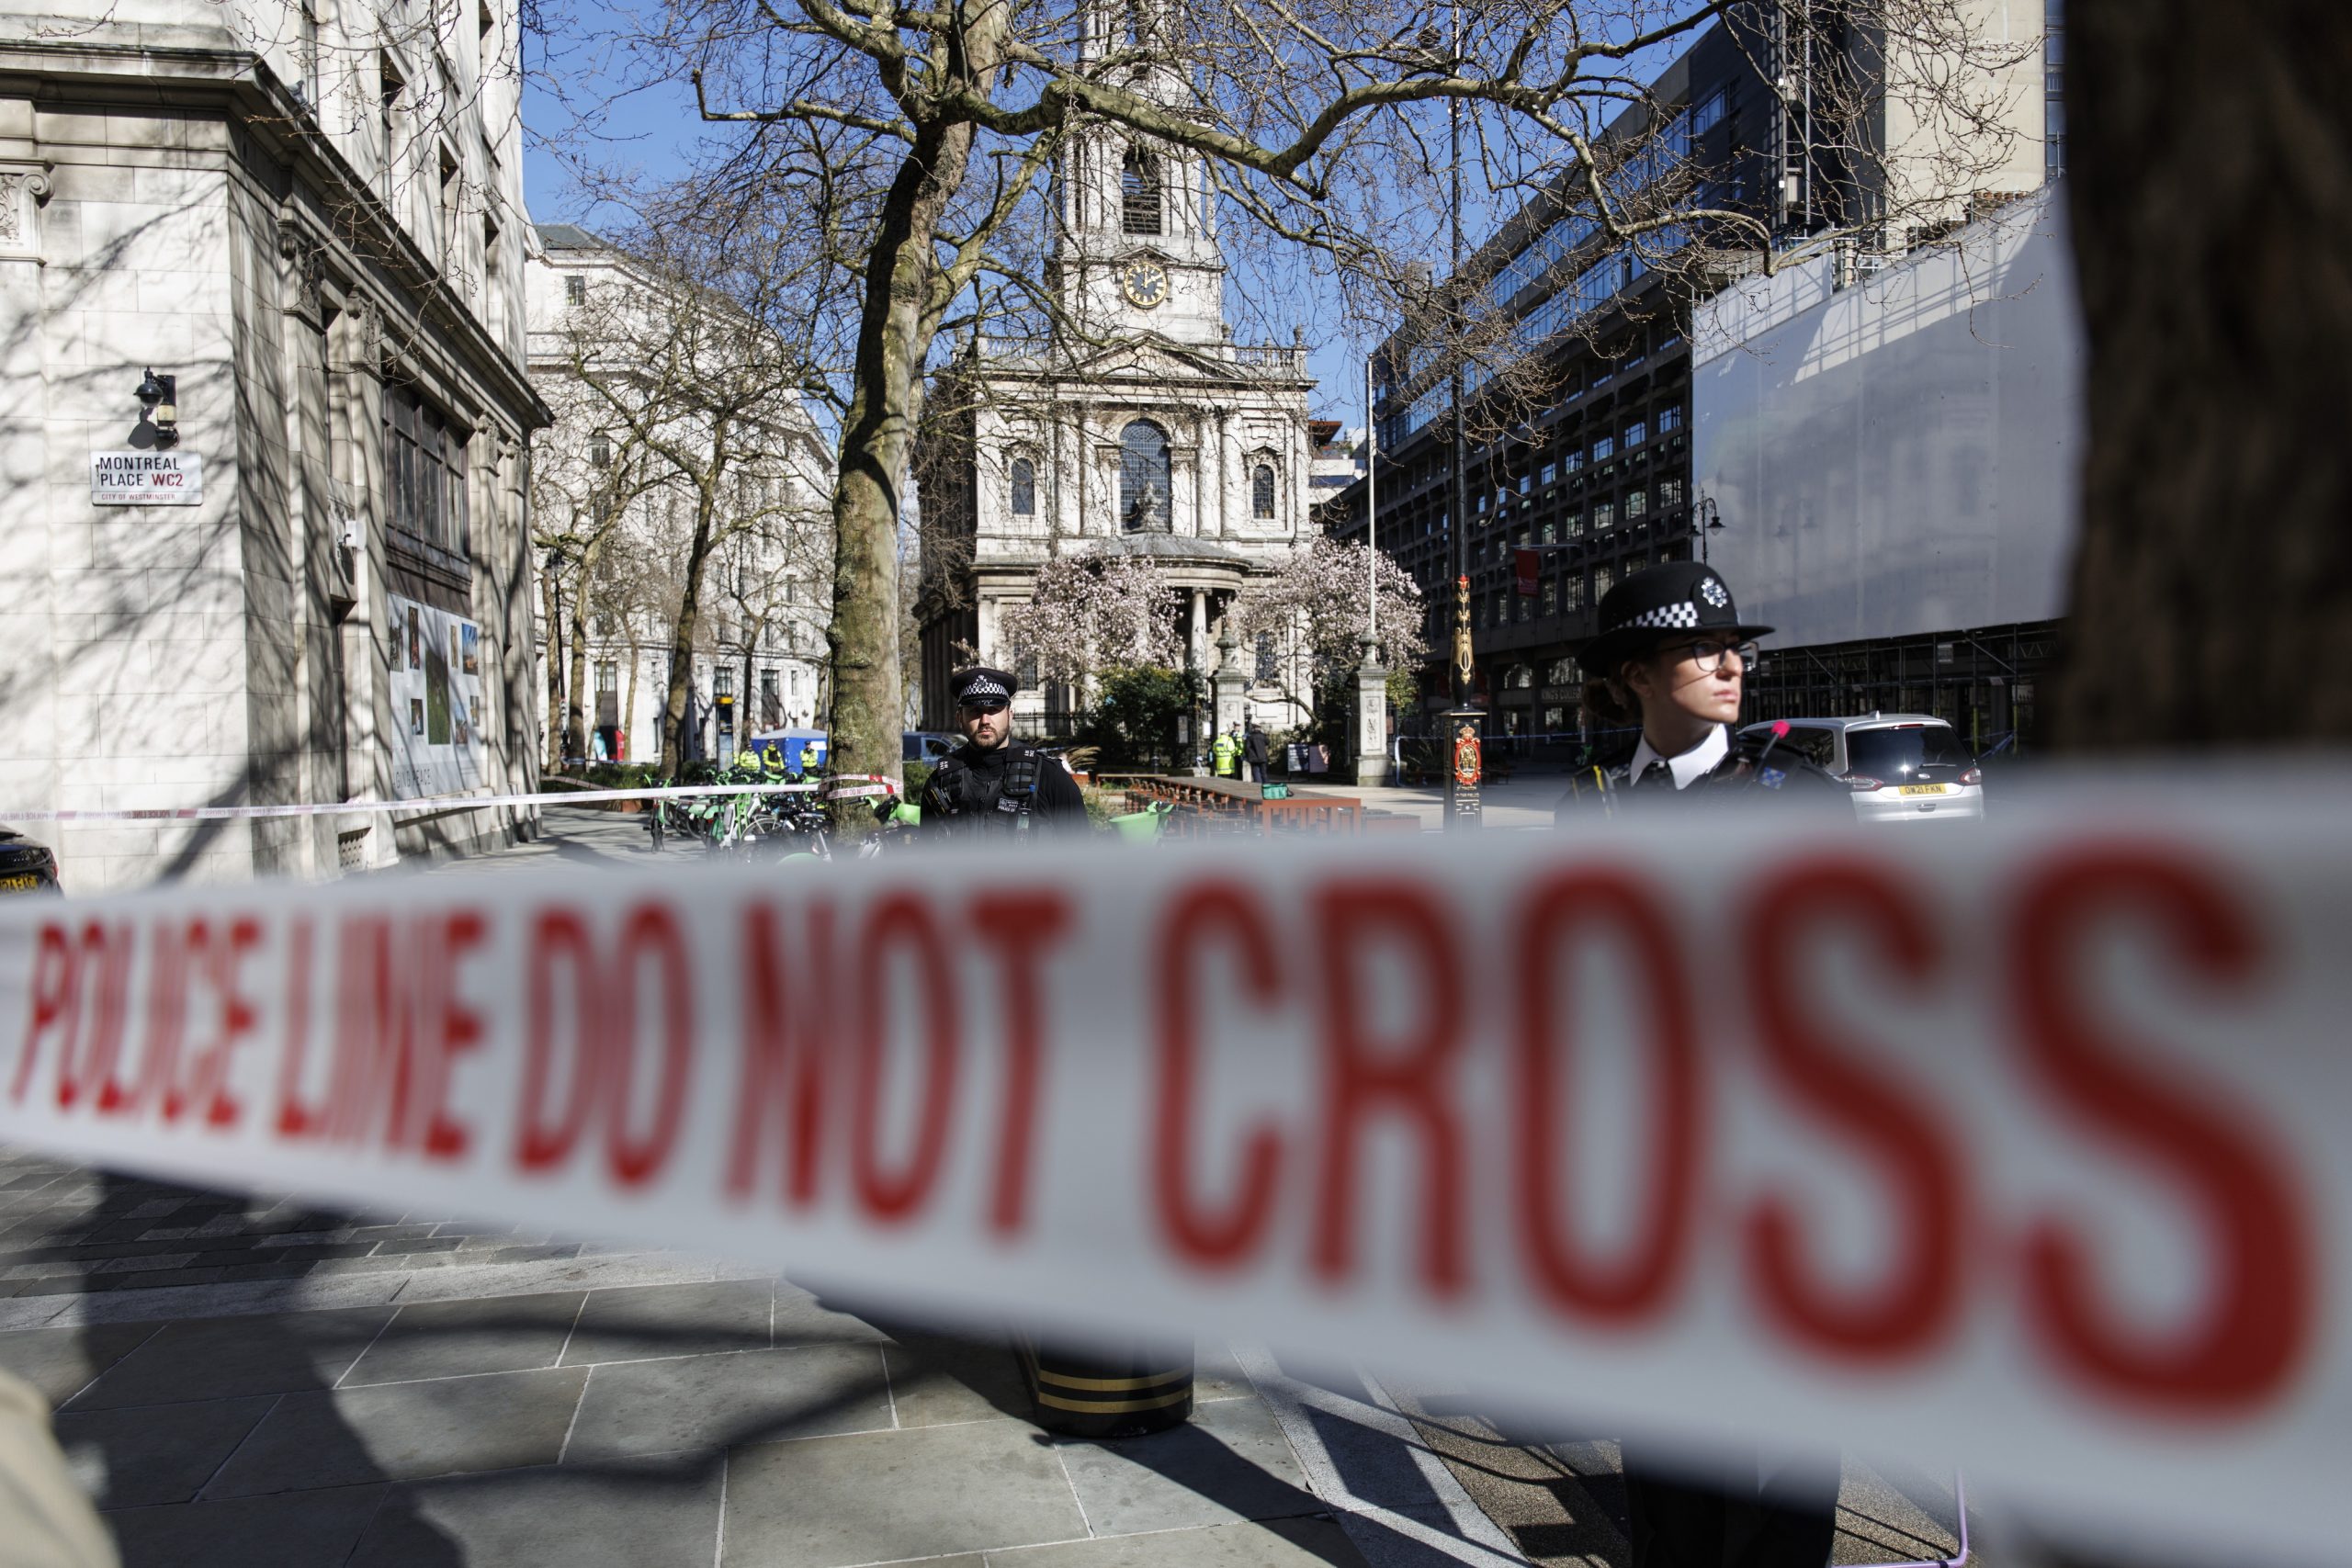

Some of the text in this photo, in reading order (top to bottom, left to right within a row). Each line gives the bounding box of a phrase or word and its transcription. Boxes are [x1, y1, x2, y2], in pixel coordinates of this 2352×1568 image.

[99, 457, 180, 469] MONTREAL
[100, 473, 184, 486] PLACE WC2
[11, 841, 2317, 1437] POLICE LINE DO NOT CROSS
